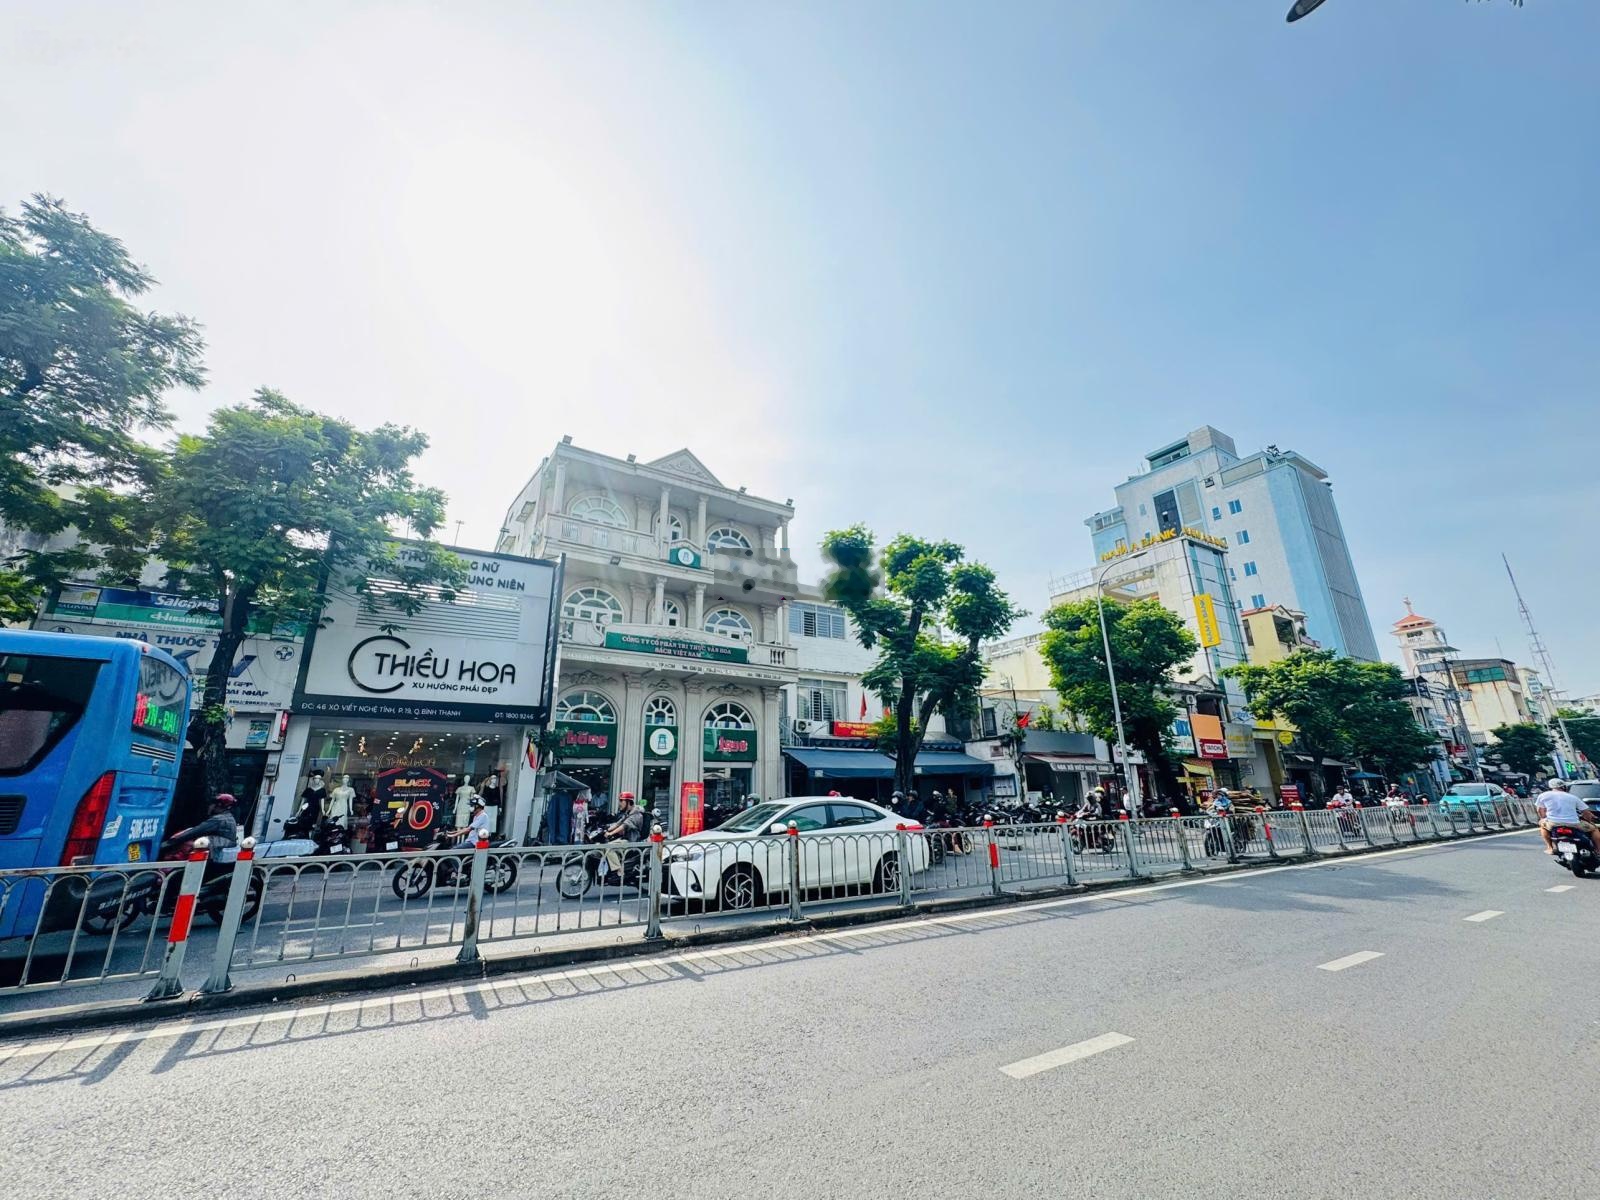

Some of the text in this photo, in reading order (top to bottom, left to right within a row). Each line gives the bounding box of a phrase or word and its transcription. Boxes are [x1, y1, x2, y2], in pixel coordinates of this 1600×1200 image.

[482, 560, 500, 573] NỮ
[497, 578, 525, 591] NIÊN
[156, 634, 207, 648] THUỐC
[622, 635, 640, 644] CÔNG
[375, 648, 516, 685] THIỀU HOA
[426, 682, 458, 692] HƯỚNG
[460, 684, 479, 692] PHÁI
[481, 686, 498, 694] ĐẸP
[328, 703, 340, 711] XÔ
[341, 703, 358, 712] VIẾT
[394, 779, 431, 787] BLACK
